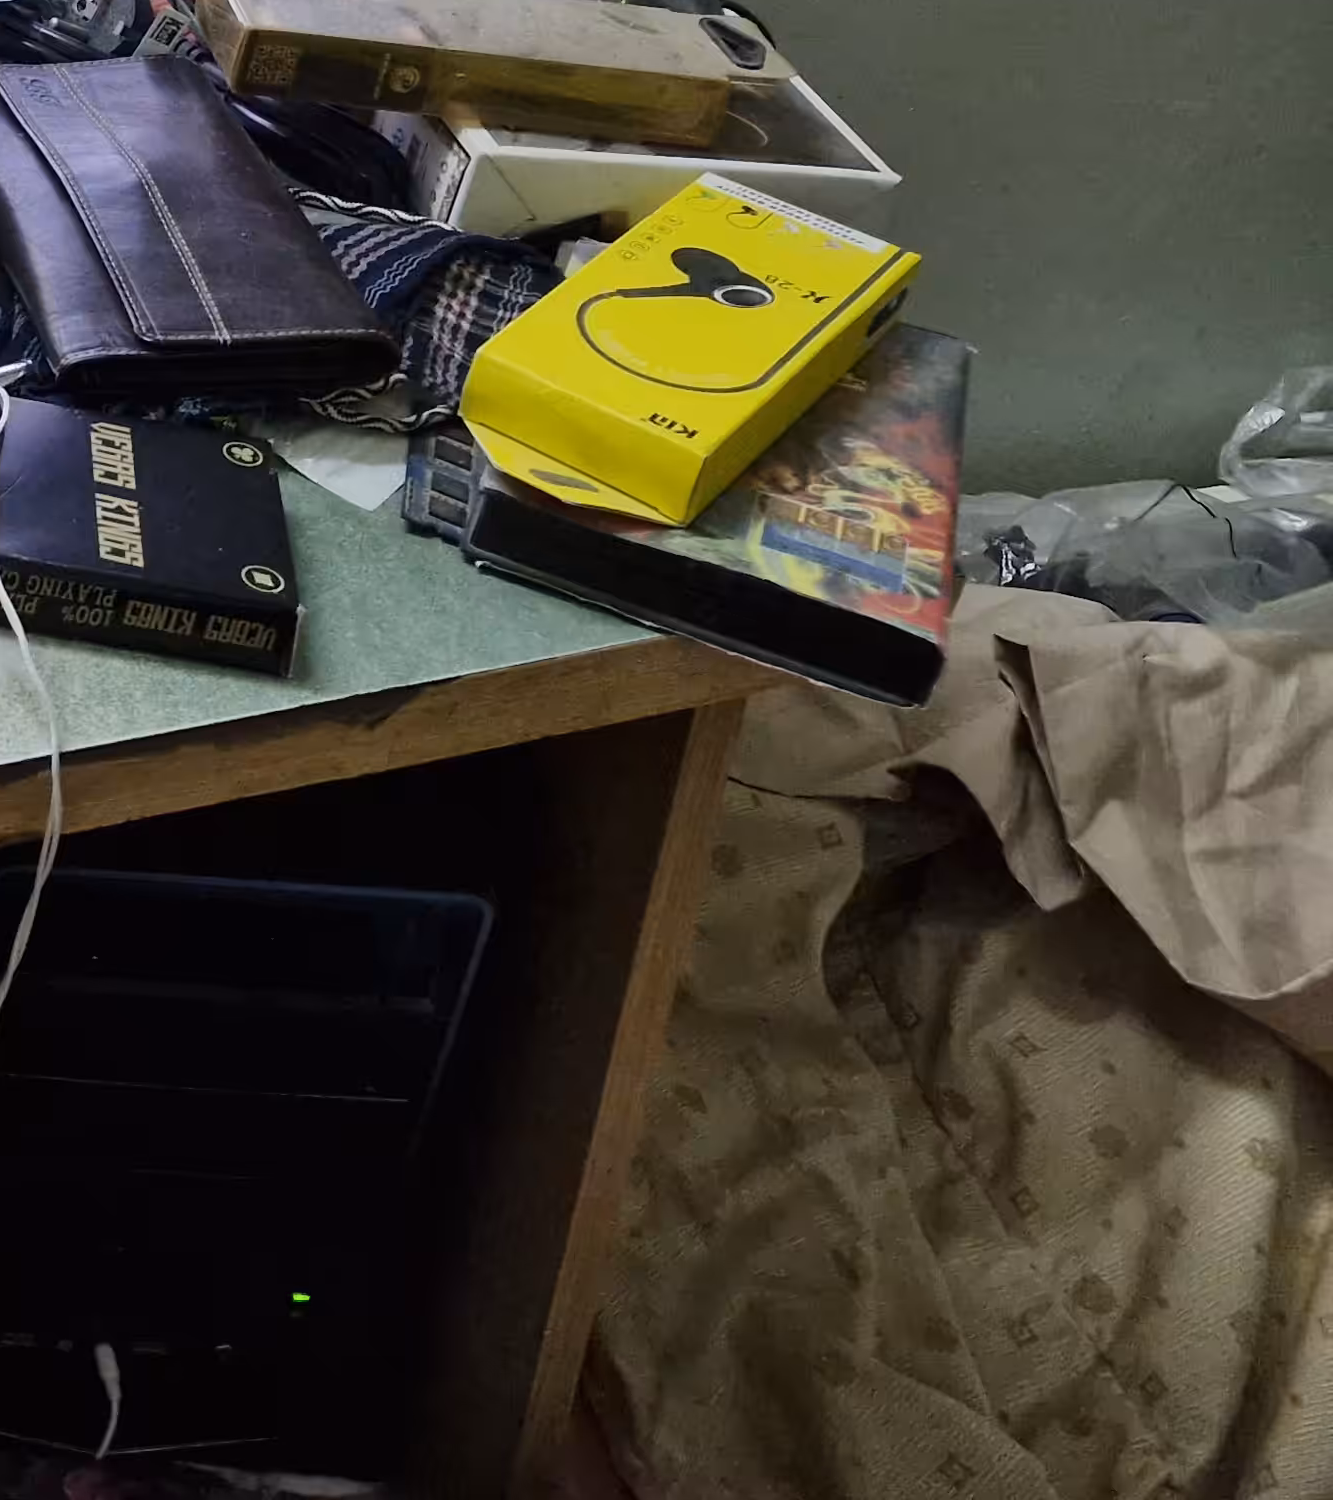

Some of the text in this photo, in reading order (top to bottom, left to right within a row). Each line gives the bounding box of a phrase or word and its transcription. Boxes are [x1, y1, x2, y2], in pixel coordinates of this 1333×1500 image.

[90, 421, 145, 568] VEGAS KINGS
[26, 574, 117, 608] PLAYING
[61, 606, 115, 628] 100%
[124, 600, 277, 651] VEGAS KINGS
